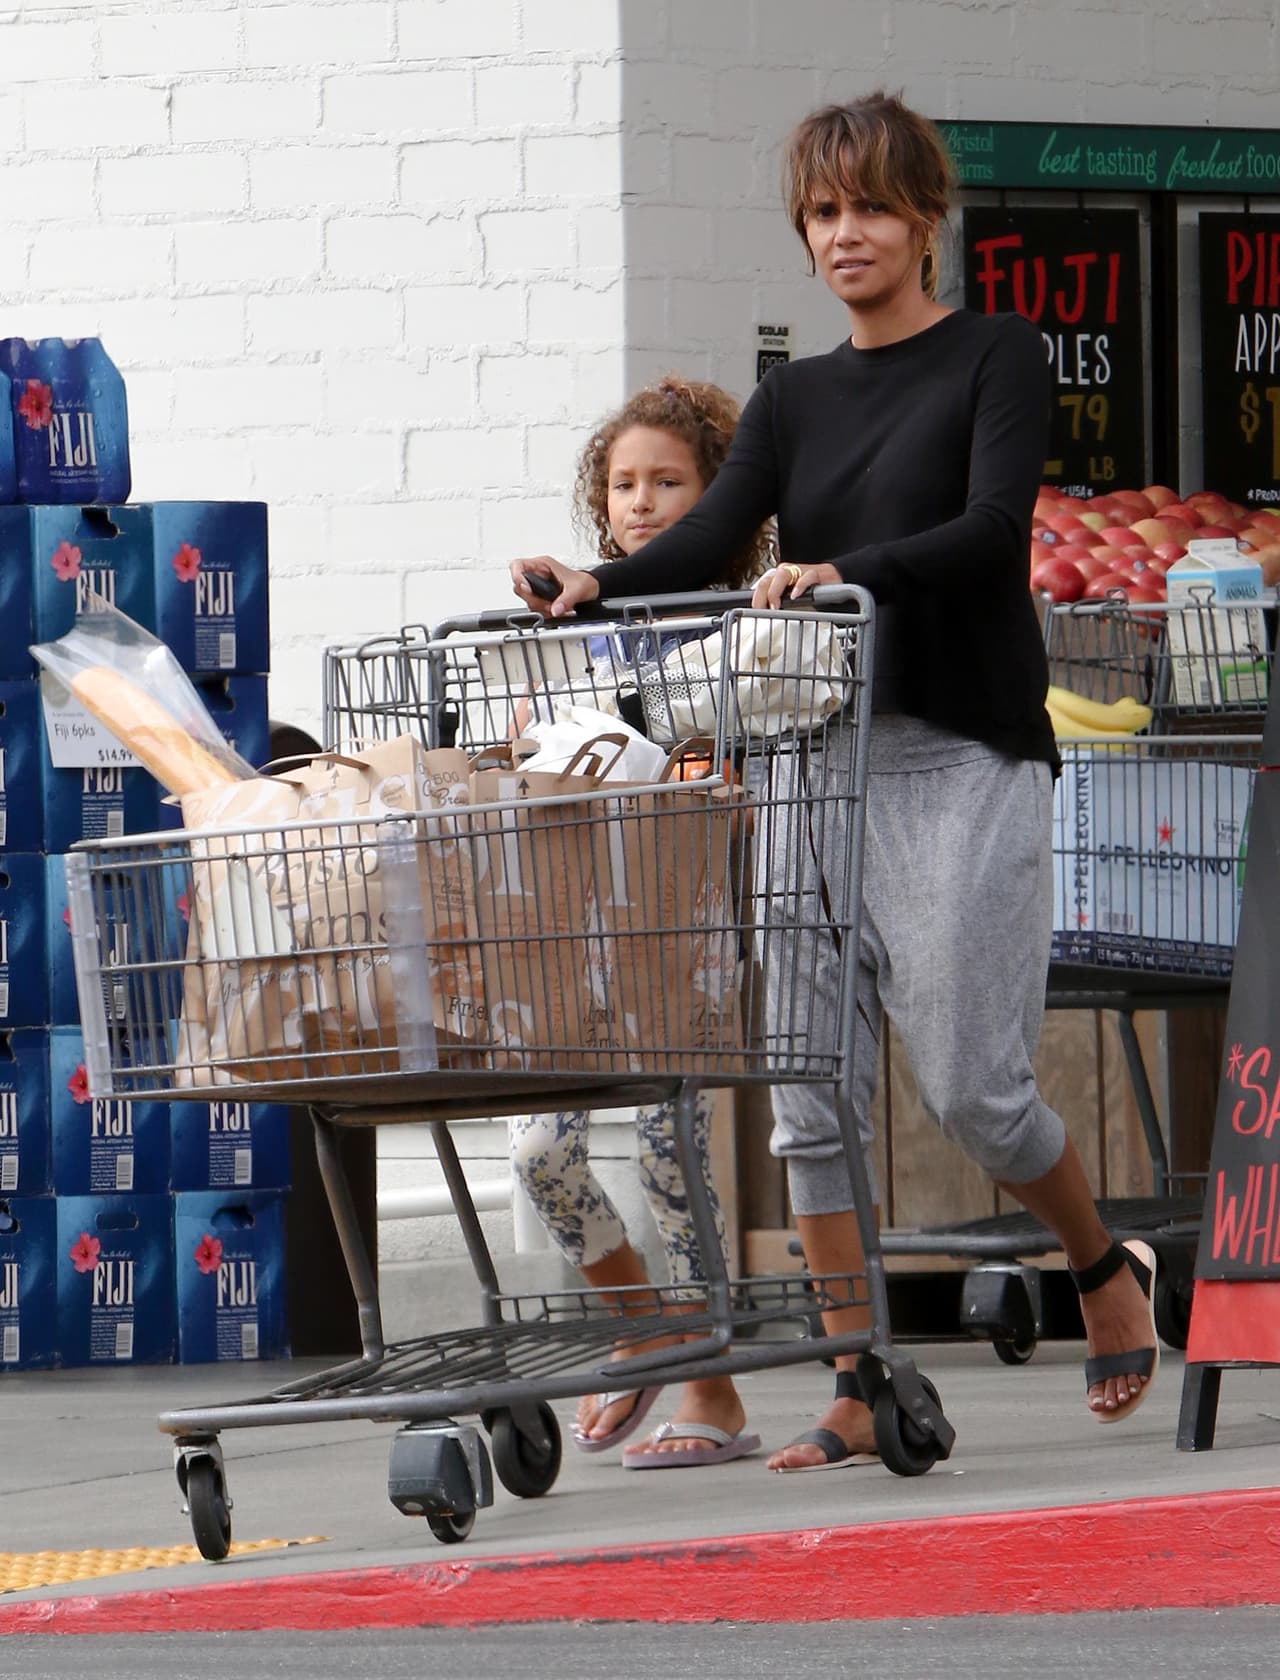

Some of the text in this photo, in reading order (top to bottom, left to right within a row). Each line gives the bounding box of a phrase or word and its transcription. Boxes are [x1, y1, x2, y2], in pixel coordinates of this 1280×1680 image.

[951, 153, 995, 181] arms
[1038, 130, 1280, 190] best tasting freshest foo
[974, 233, 1121, 325] FUJI
[49, 412, 97, 468] FIJI
[1058, 393, 1109, 442] 79
[1089, 456, 1115, 481] LB
[76, 569, 116, 615] FIJI
[195, 571, 235, 616] FIJI
[54, 724, 96, 742] Fiji 6pks
[98, 749, 133, 762] $14.99
[82, 767, 124, 793] FIJI
[91, 1099, 134, 1137] FIJI
[209, 1102, 251, 1132] FIJI
[1211, 1162, 1280, 1267] WH
[92, 1260, 134, 1306] FIJI
[216, 1261, 257, 1307] FIJI
